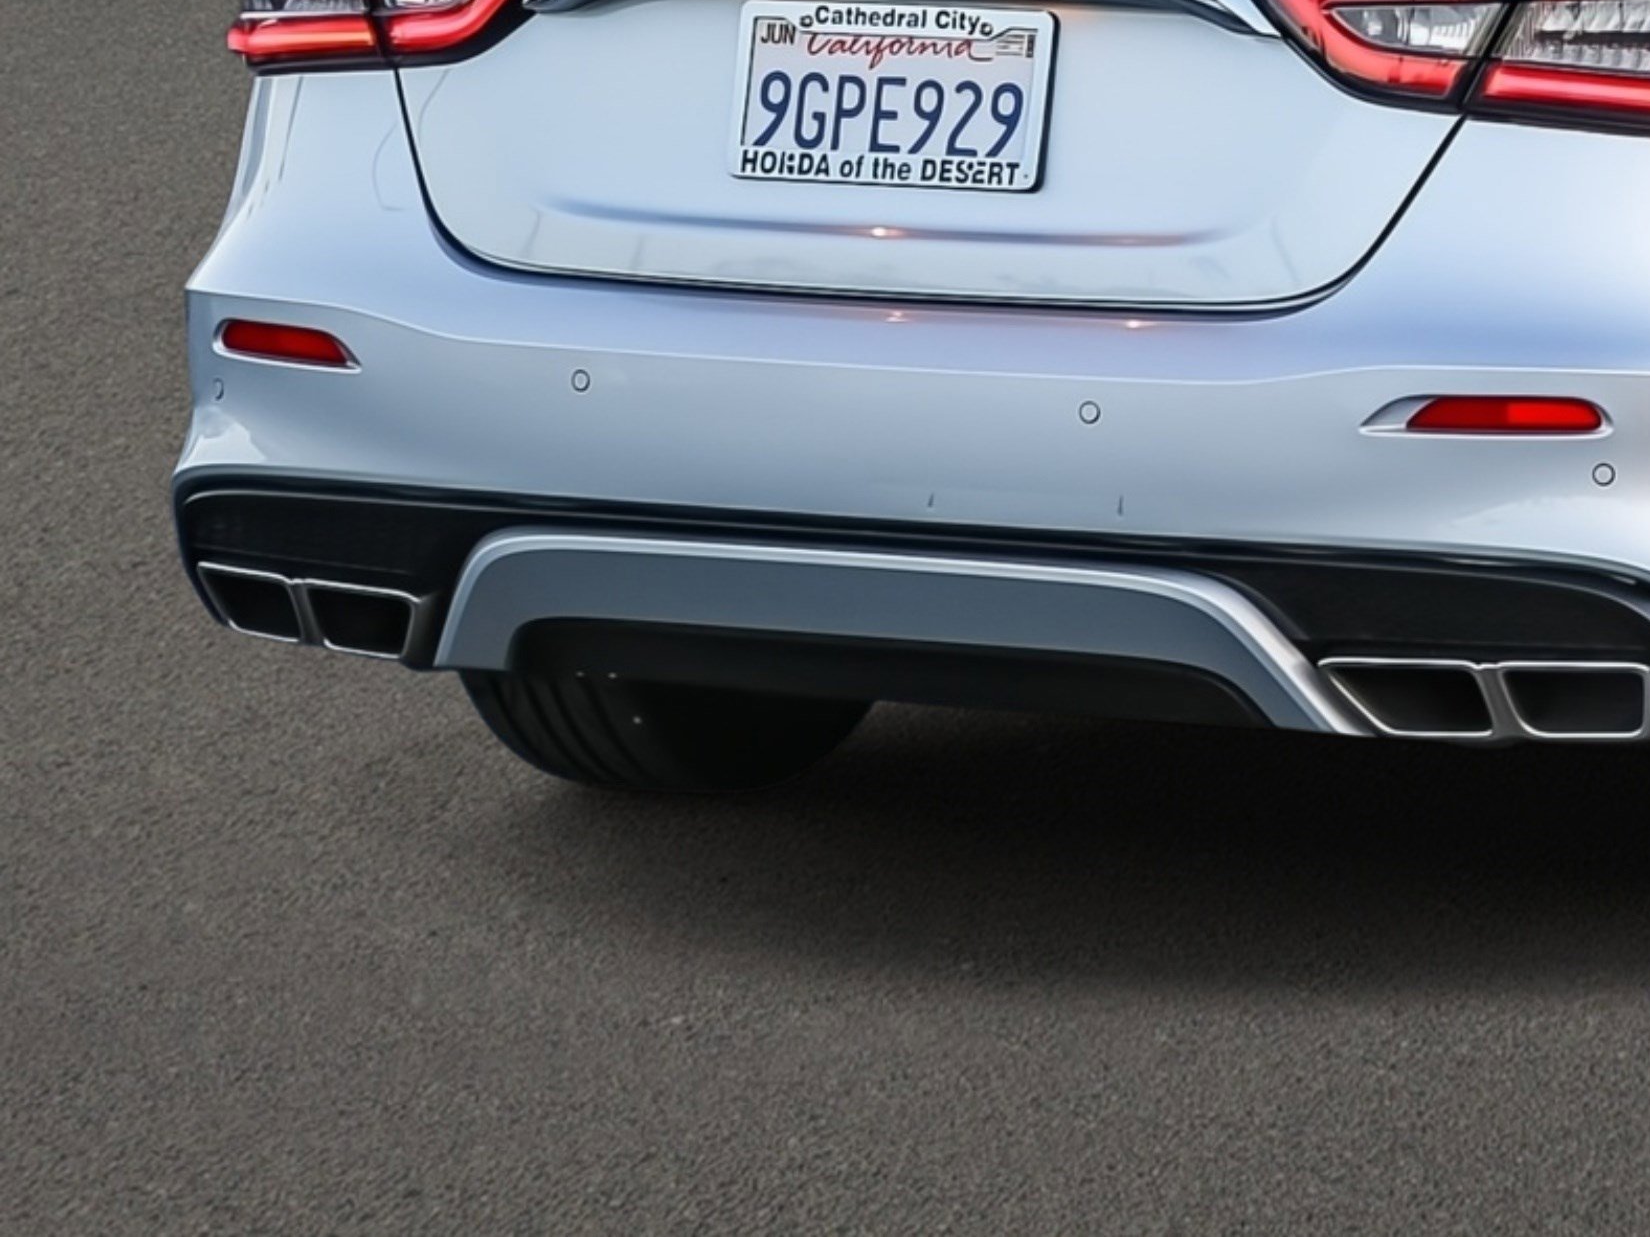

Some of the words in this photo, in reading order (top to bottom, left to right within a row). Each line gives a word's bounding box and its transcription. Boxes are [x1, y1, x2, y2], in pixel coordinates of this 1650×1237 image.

[760, 23, 796, 45] JUN
[815, 5, 927, 29] Cathedral
[934, 10, 980, 36] City
[752, 70, 1025, 158] 9GPE929
[740, 149, 830, 177] HONDA
[839, 156, 864, 180] of
[871, 157, 911, 182] the
[920, 160, 1020, 186] DESERT
